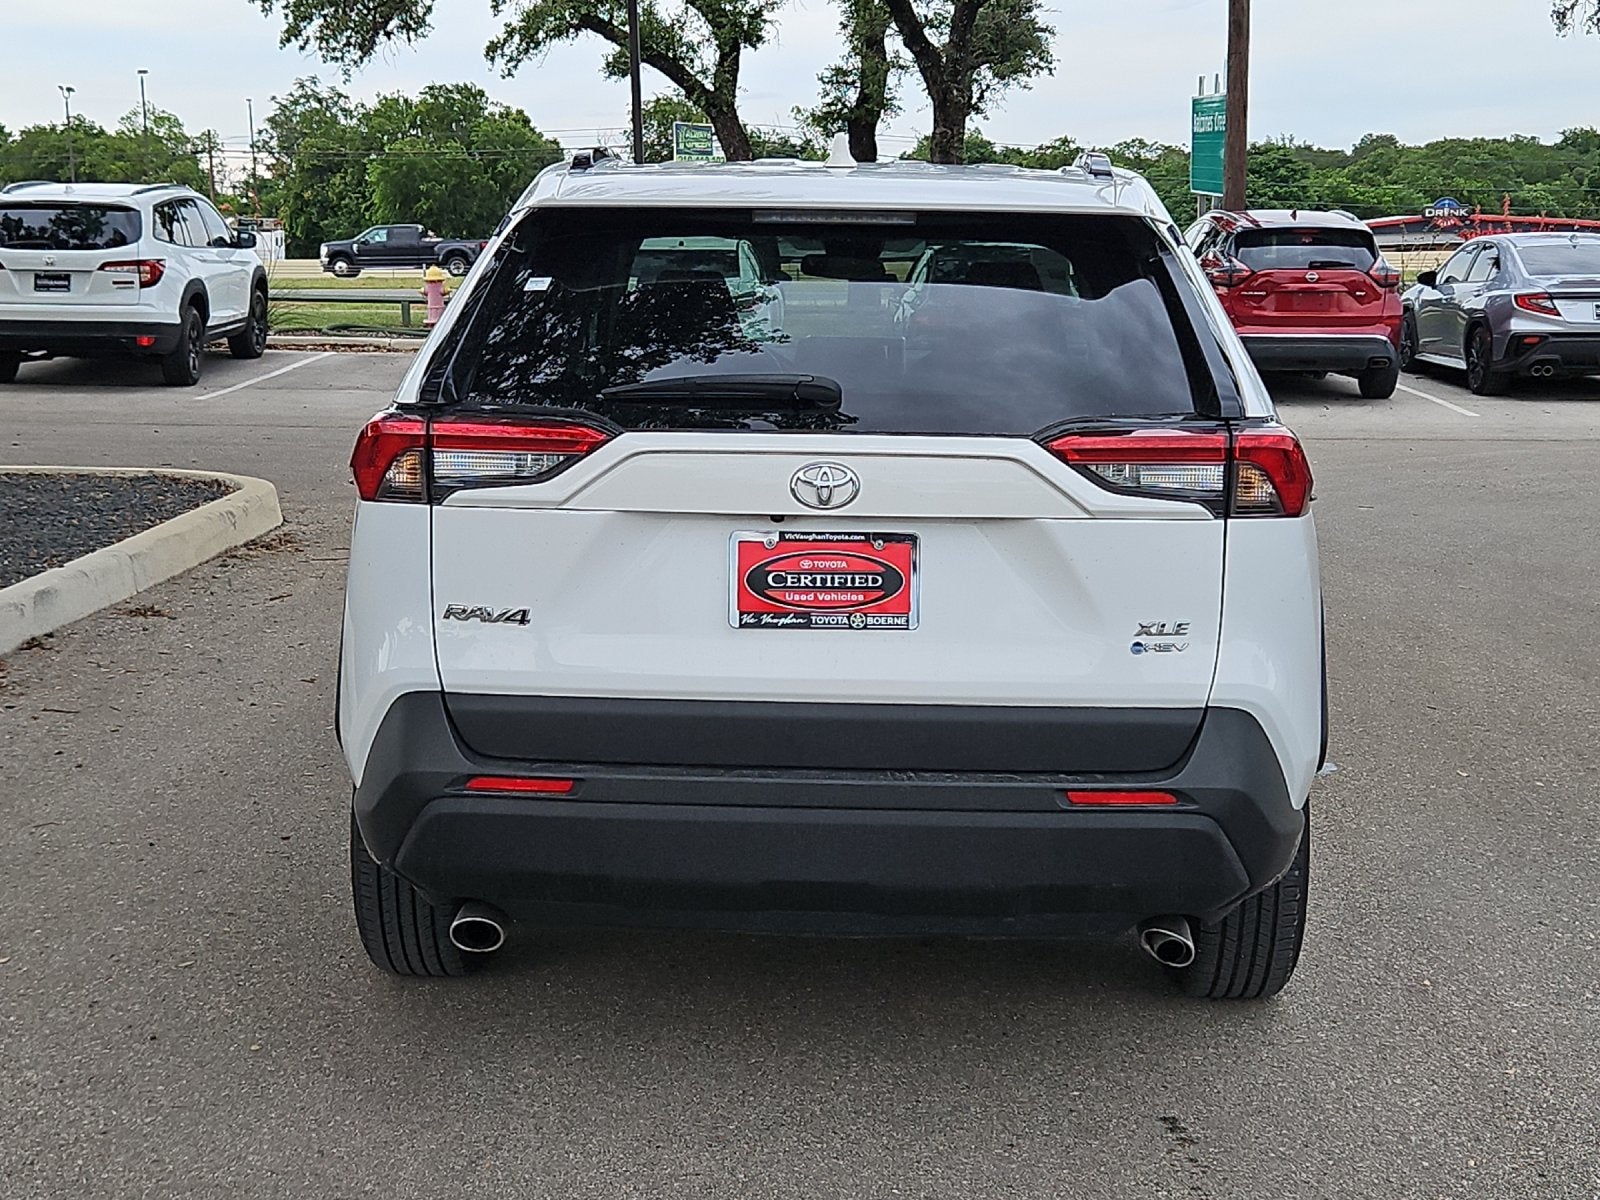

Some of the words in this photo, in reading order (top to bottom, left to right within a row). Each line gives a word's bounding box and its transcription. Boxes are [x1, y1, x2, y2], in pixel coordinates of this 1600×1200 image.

[1425, 208, 1468, 217] DRINK
[784, 533, 866, 541] VicVaughanToyota.com
[813, 560, 848, 569] TOYOTA
[785, 592, 814, 601] Used
[817, 592, 865, 601] Vehicles
[443, 604, 531, 626] RAV4
[810, 616, 850, 625] TOYOTA
[866, 617, 908, 625] BOERNE
[1133, 621, 1191, 637] XLE
